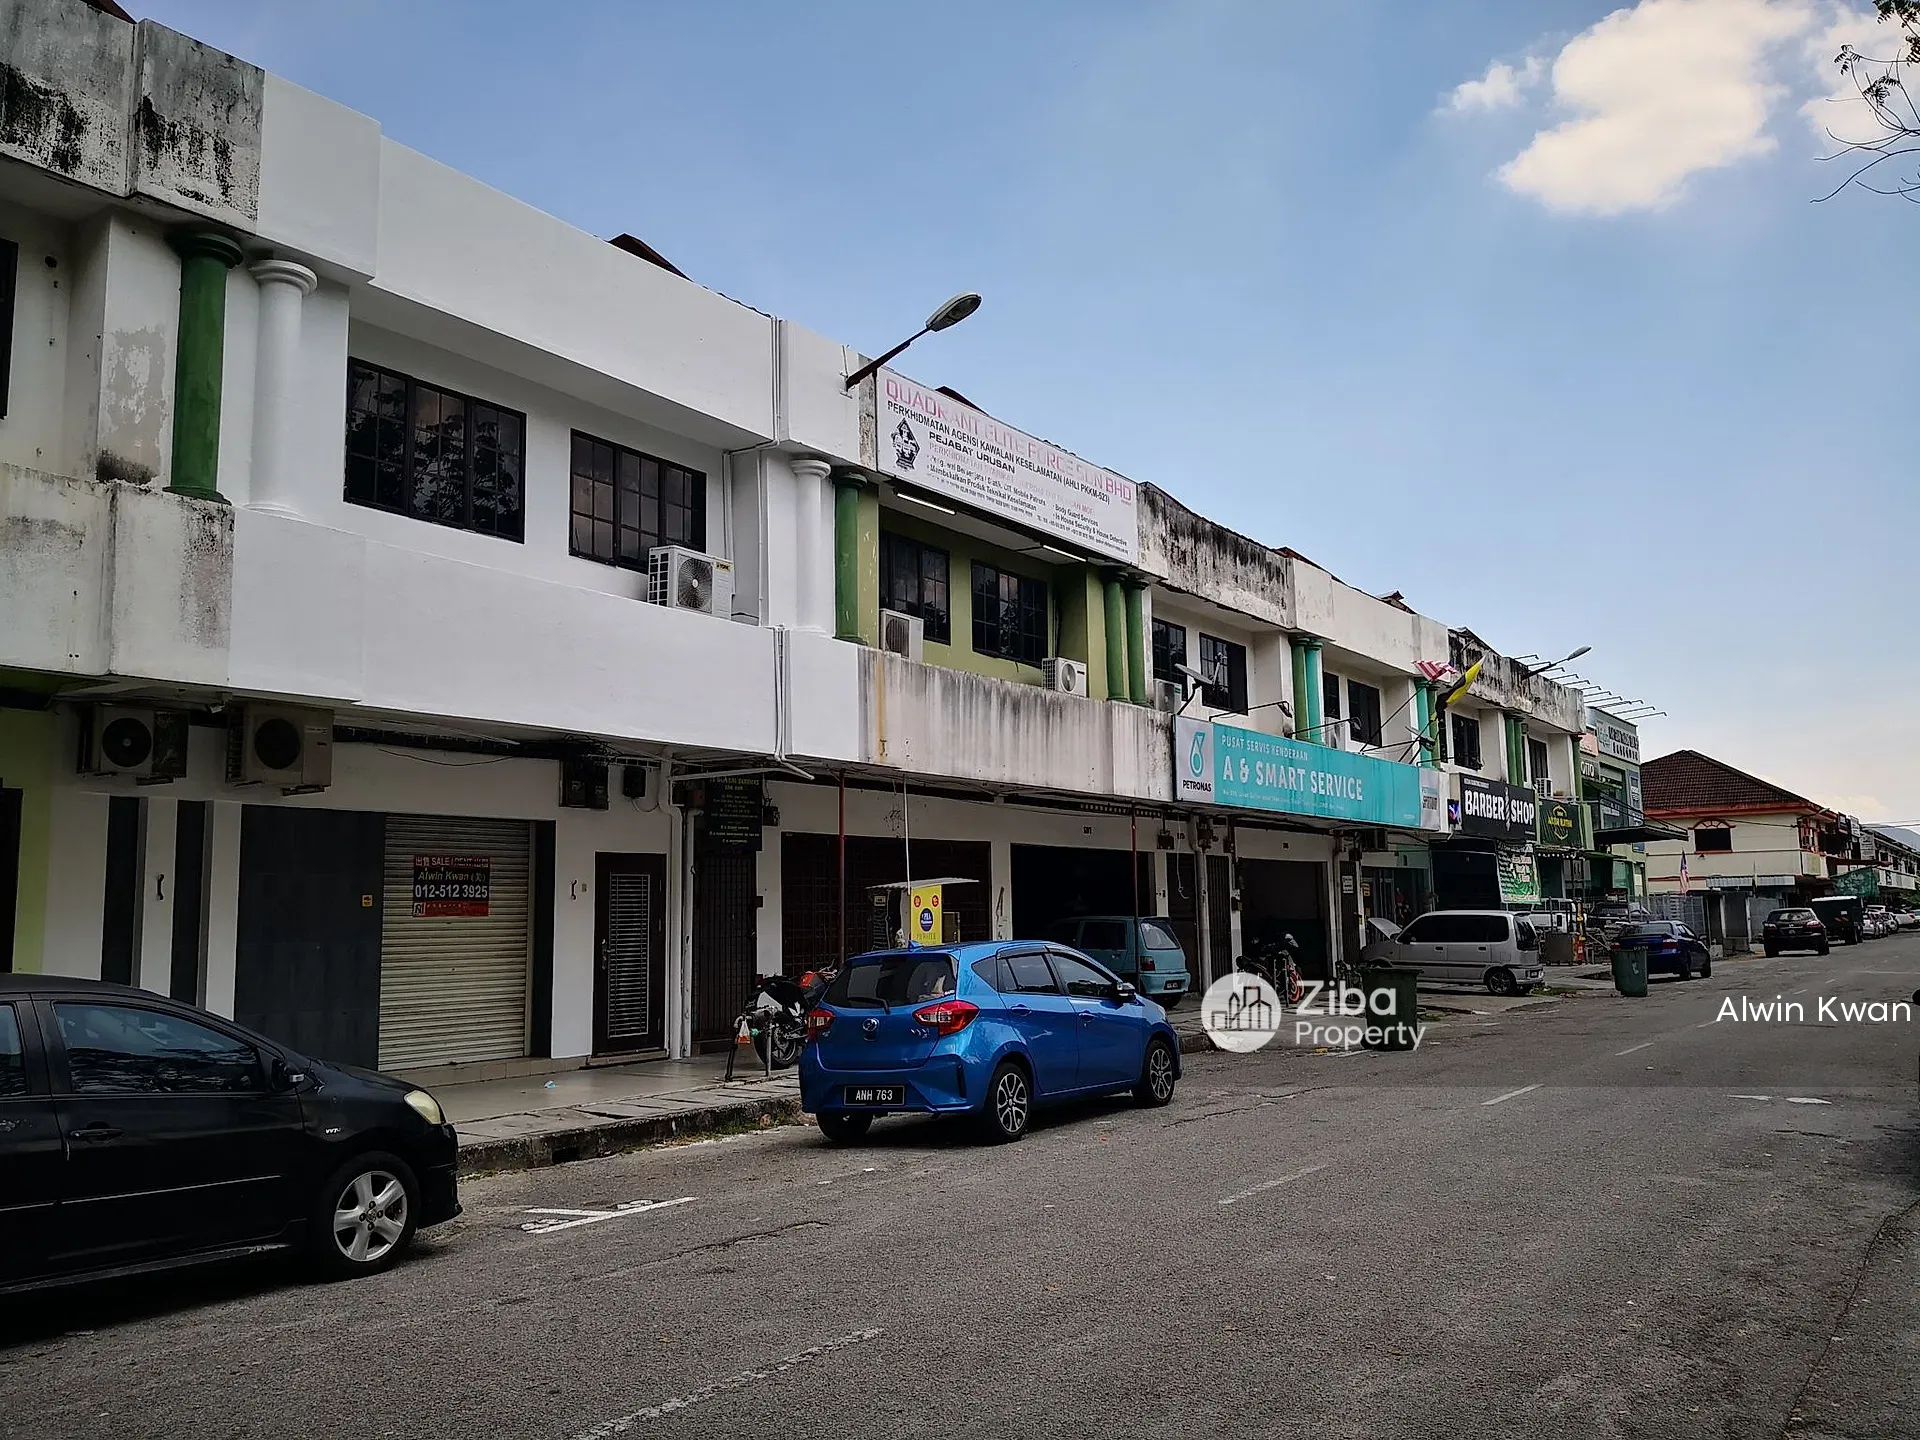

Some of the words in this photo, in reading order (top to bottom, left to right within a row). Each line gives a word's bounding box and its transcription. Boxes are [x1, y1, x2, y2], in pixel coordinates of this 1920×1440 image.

[887, 400, 950, 436] PERKHIDMATAN
[951, 428, 979, 447] AGENSI
[980, 439, 1014, 464] KAWALAN
[1015, 455, 1063, 483] KESELAMATAN
[929, 431, 974, 456] PEJABAT
[976, 451, 1015, 474] URUSAN
[1105, 476, 1131, 501] BHD
[1221, 734, 1245, 750] PUSAT
[1246, 739, 1270, 755] SERVIS
[1272, 745, 1309, 761] KENDERAAN
[1182, 779, 1212, 793] PETRONAS
[1223, 756, 1234, 782] A
[1239, 758, 1250, 784] &
[1256, 760, 1306, 792] SMART
[1310, 770, 1364, 801] SERVICE
[1464, 789, 1505, 820] BARBER
[1510, 799, 1535, 826] SHOP
[432, 857, 451, 866] SALE
[445, 871, 470, 881] Kwan
[414, 884, 460, 898] 012-512
[462, 884, 488, 898] 3925
[855, 1089, 873, 1101] ANH
[876, 1089, 893, 1101] 763
